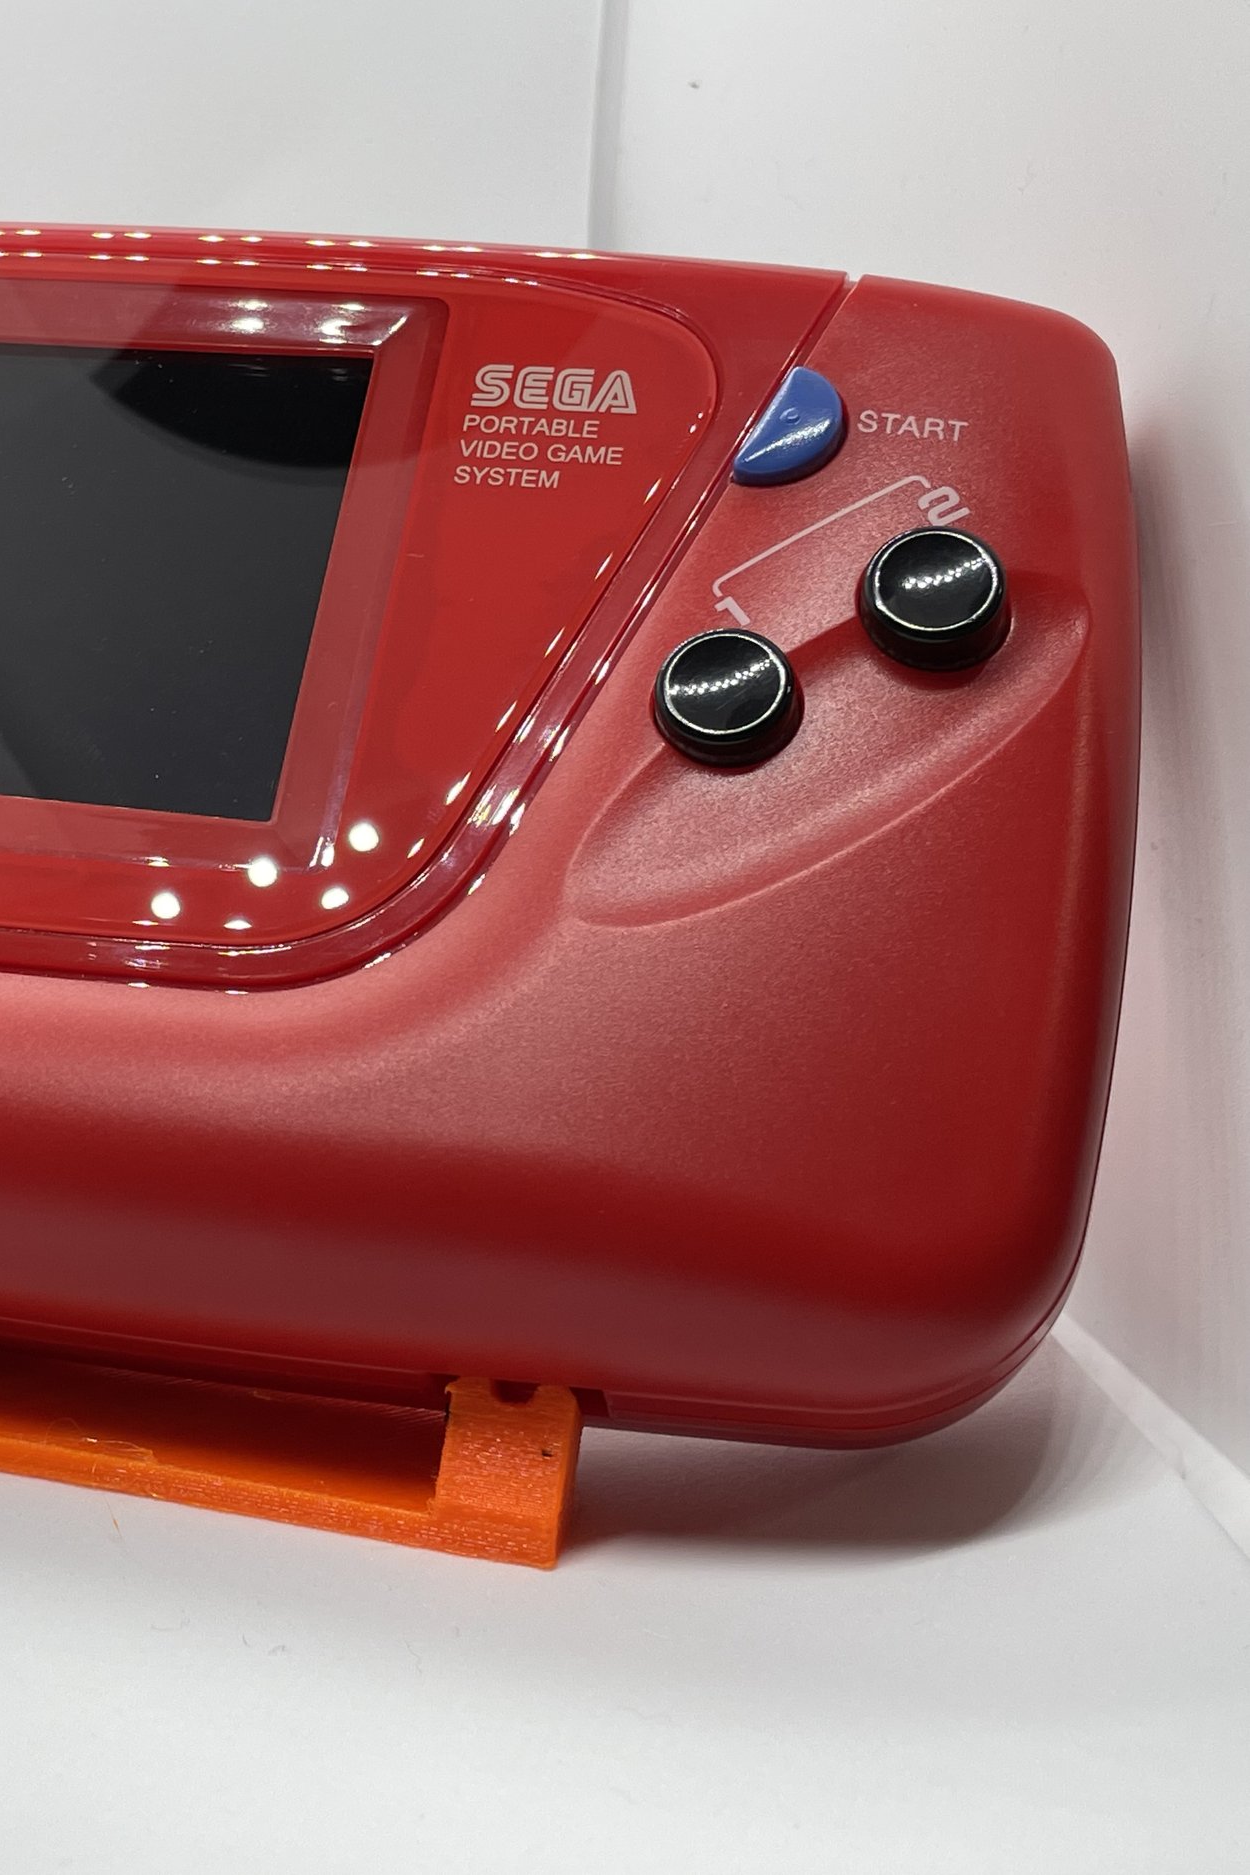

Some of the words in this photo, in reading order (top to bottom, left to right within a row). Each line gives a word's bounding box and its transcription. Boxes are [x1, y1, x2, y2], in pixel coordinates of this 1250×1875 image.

[470, 364, 638, 414] SEGA
[462, 414, 600, 439] PORTABLE
[857, 410, 969, 442] START
[460, 439, 539, 461] VIDEO
[546, 444, 624, 465] GAME
[453, 465, 560, 489] SYSTEM
[917, 486, 971, 527] 2
